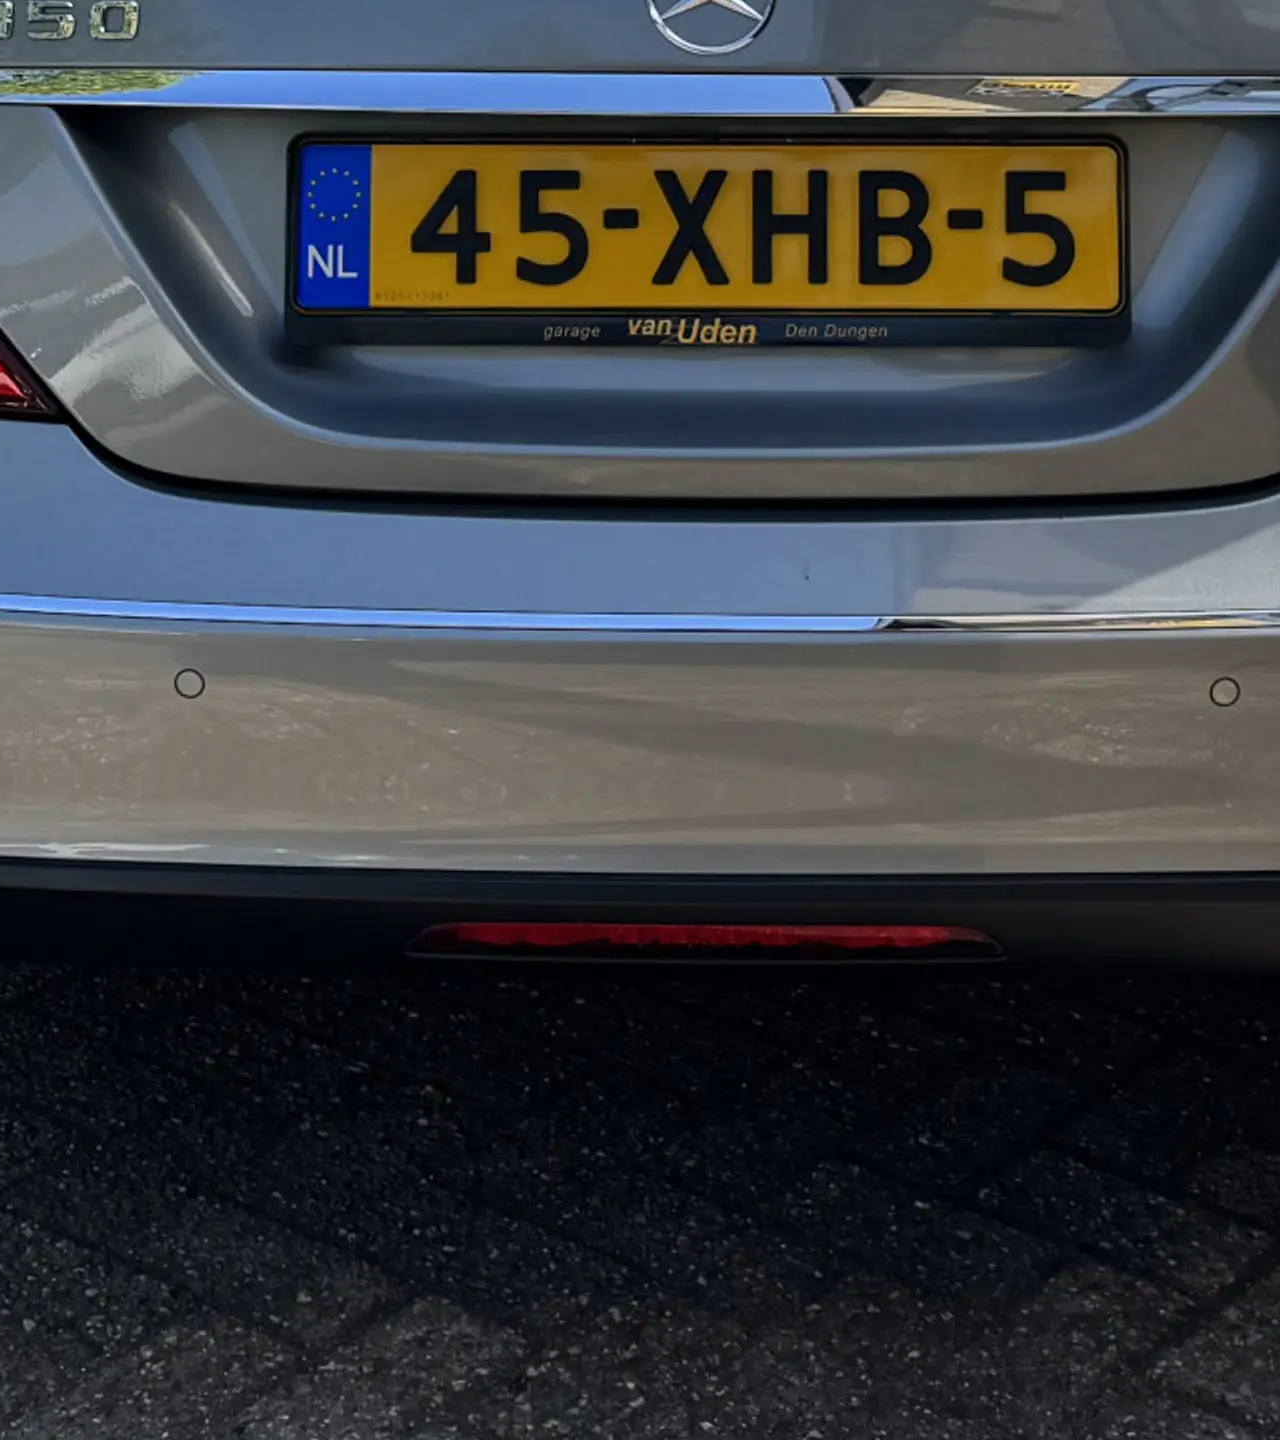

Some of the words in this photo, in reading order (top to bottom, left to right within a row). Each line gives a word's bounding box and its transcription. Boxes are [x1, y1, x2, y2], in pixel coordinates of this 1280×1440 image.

[410, 168, 1077, 288] 45-XHB-5
[307, 244, 358, 279] NL
[544, 325, 601, 340] garage
[627, 317, 672, 336] van
[676, 318, 758, 344] Uden
[785, 324, 818, 338] Den
[824, 324, 889, 341] Dungen
